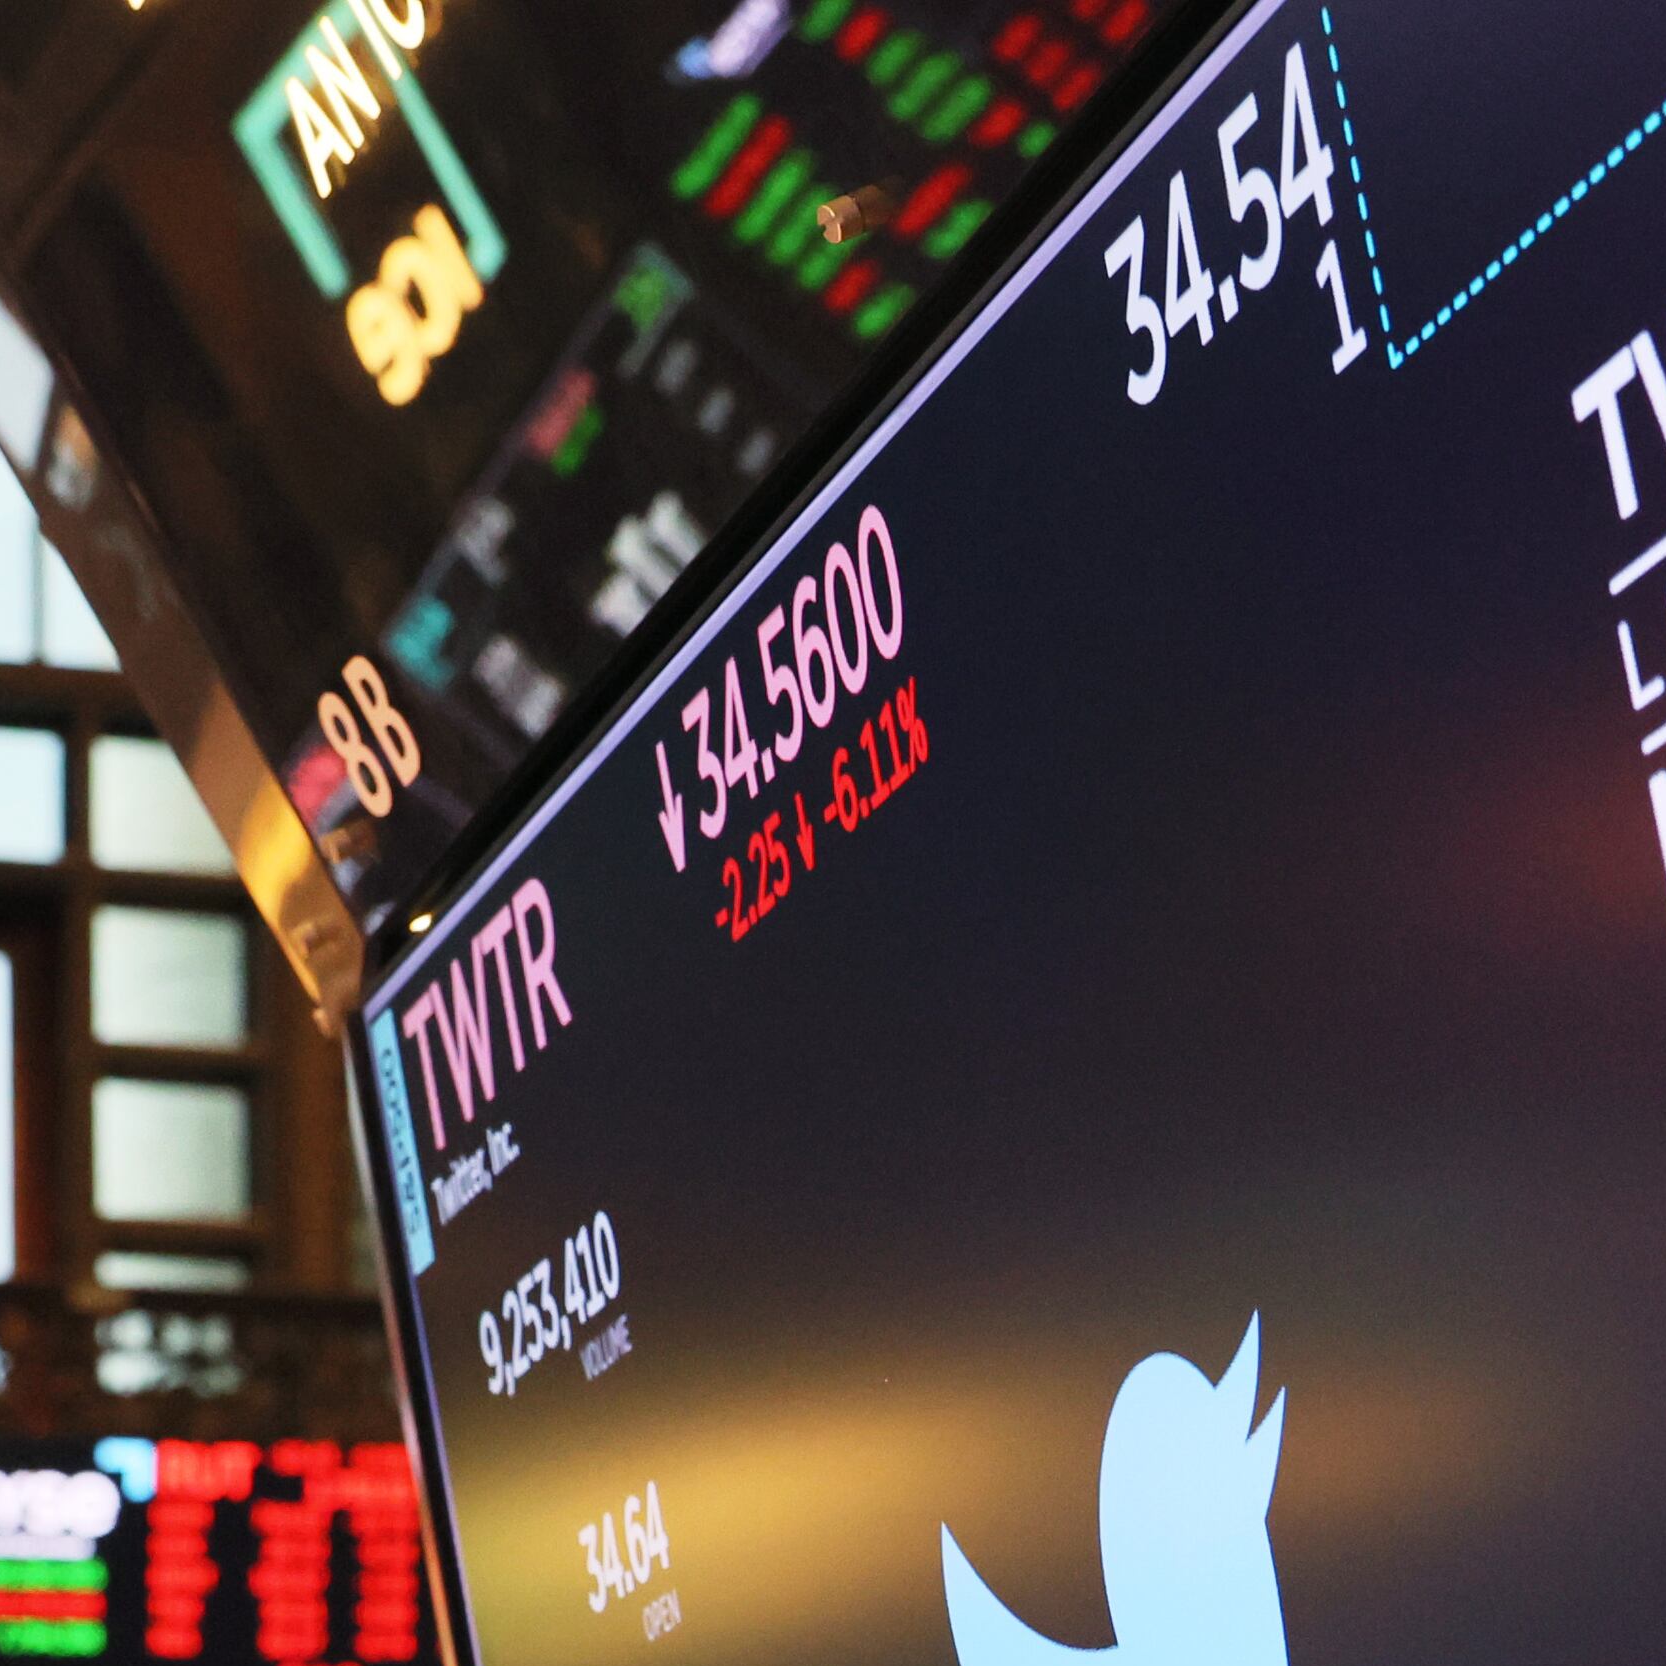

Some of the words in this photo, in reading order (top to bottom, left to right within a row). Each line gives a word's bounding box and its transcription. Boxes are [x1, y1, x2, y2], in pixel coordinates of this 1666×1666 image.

[285, 15, 381, 199] AN
[1104, 42, 1334, 405] 34.54
[1315, 239, 1367, 375] 1
[318, 655, 421, 817] 8B
[681, 504, 902, 839] 34.5600
[824, 676, 928, 832] -6.11%
[402, 878, 572, 1151] TWTR
[479, 1210, 621, 1398] 9,253,410
[579, 1480, 670, 1613] 34.64
[642, 1588, 682, 1642] OPEN
